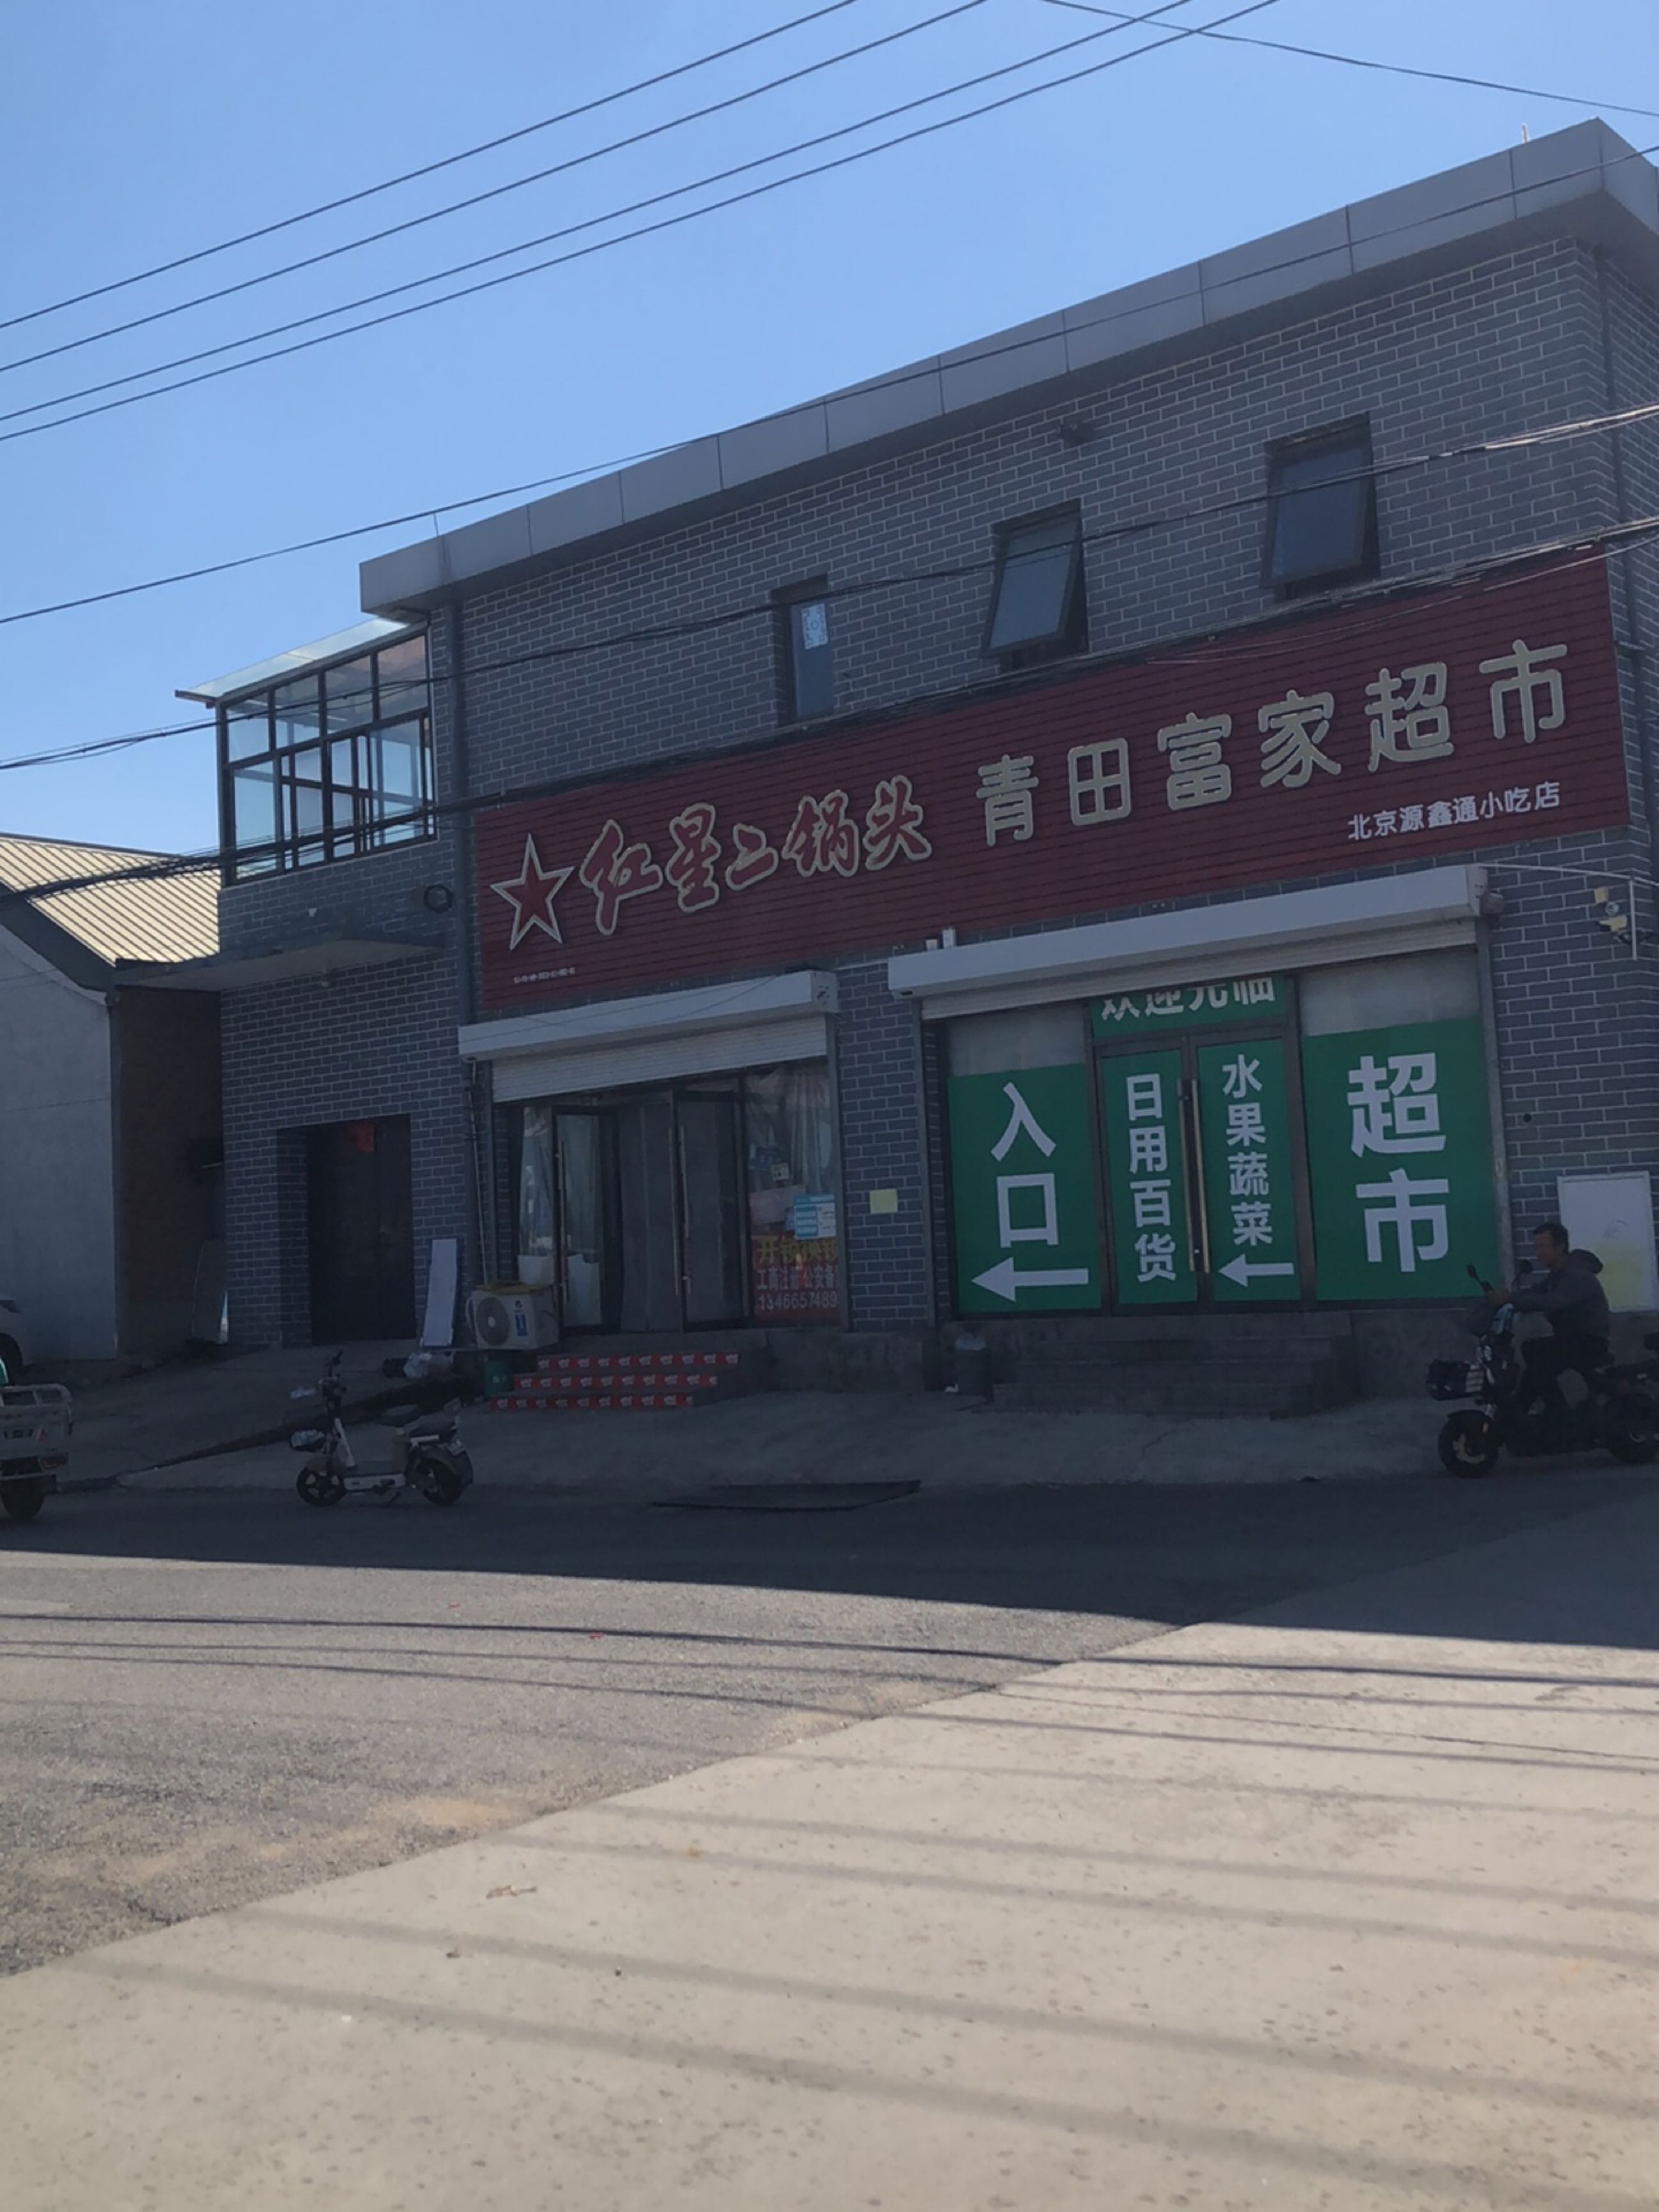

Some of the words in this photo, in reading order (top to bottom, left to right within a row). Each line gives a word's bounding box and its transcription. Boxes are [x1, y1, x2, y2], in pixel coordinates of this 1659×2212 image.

[976, 639, 1568, 847] 青田富家超市
[1347, 780, 1560, 842] 北京源鑫通小吃店
[580, 774, 932, 936] 红星二锅头
[990, 1082, 1057, 1248] 入口
[1125, 1073, 1176, 1283] 日用百货
[1222, 1054, 1273, 1246] 水果蔬菜
[1347, 1052, 1448, 1273] 超市
